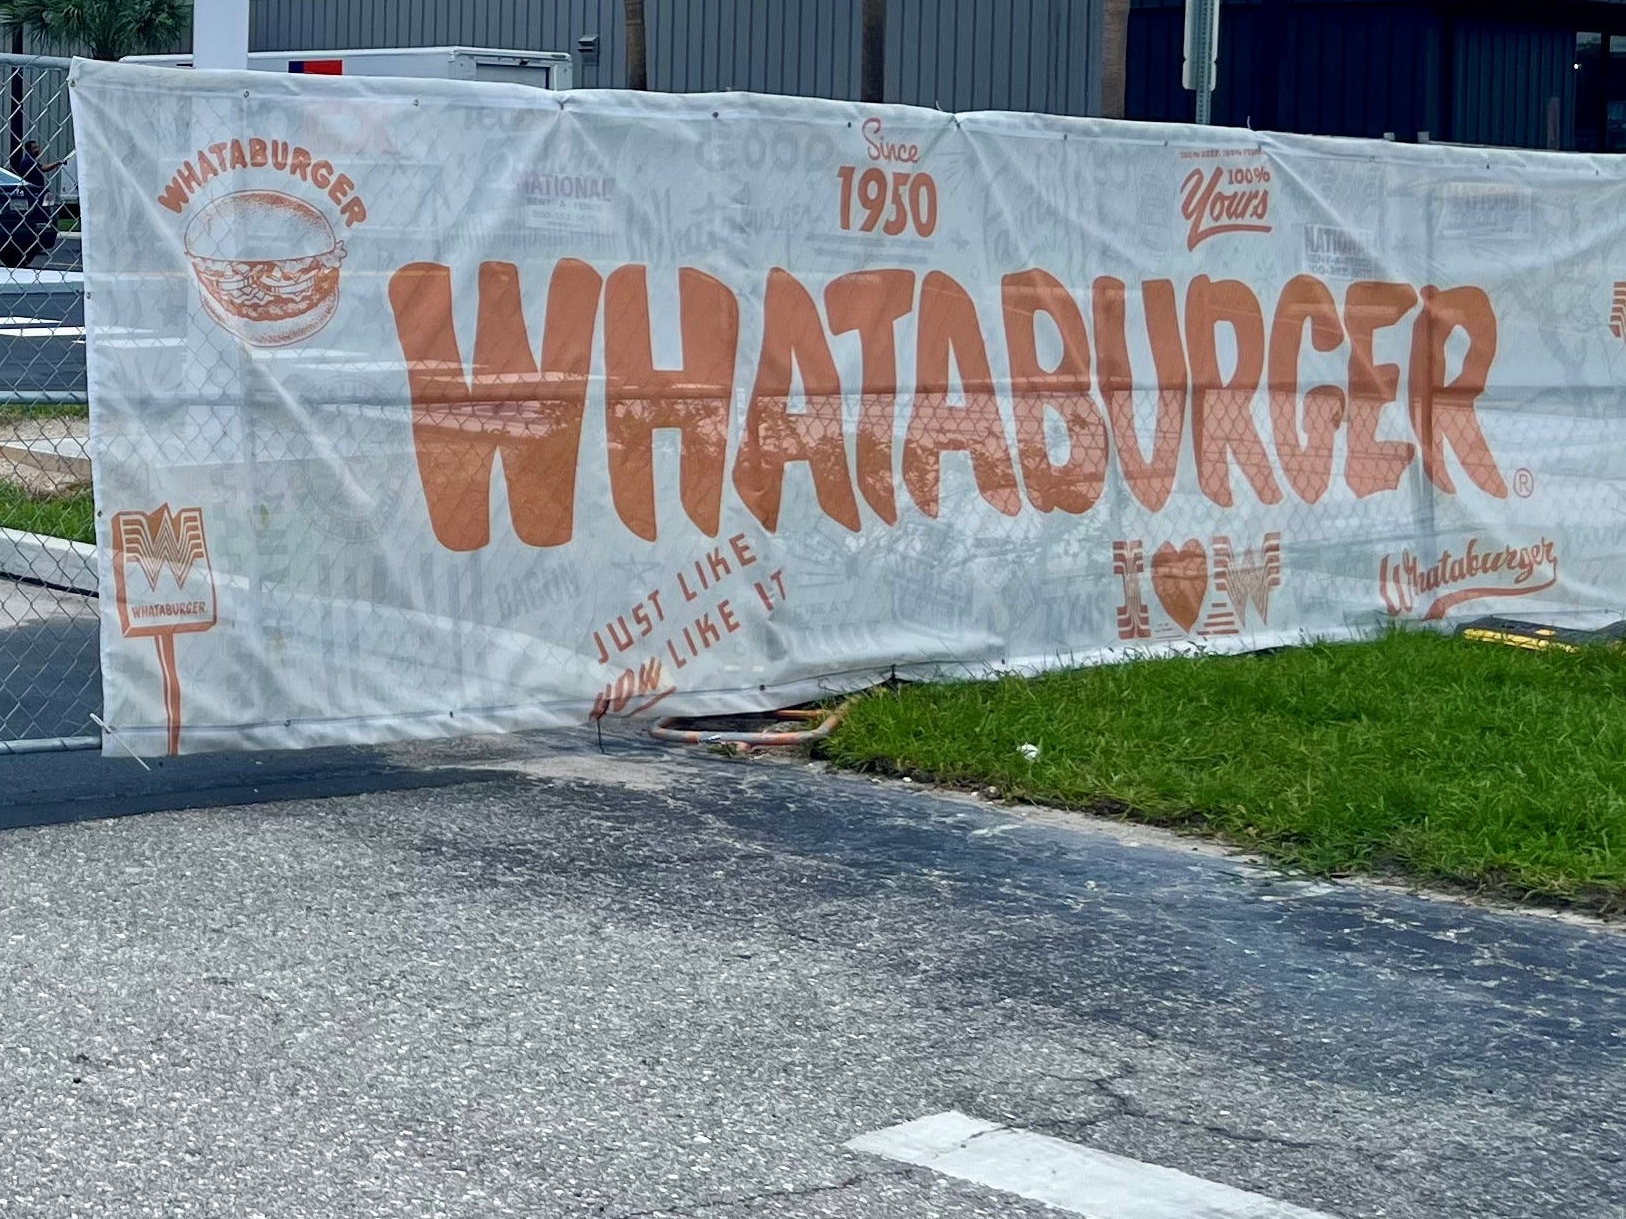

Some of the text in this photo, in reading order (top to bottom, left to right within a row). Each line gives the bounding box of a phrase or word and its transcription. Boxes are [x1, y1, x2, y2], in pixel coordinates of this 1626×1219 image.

[157, 137, 367, 228] WHATABURGER
[862, 117, 920, 163] Since
[1228, 166, 1271, 185] 100%
[837, 166, 937, 238] 1950
[1180, 166, 1272, 252] Yours
[388, 257, 1508, 553] WHATABURGER
[132, 601, 206, 619] WHATABURGER
[593, 532, 757, 665] JUST LIKE
[667, 599, 741, 669] LIKE
[754, 569, 786, 612] IT
[1379, 537, 1558, 621] Whataburger
